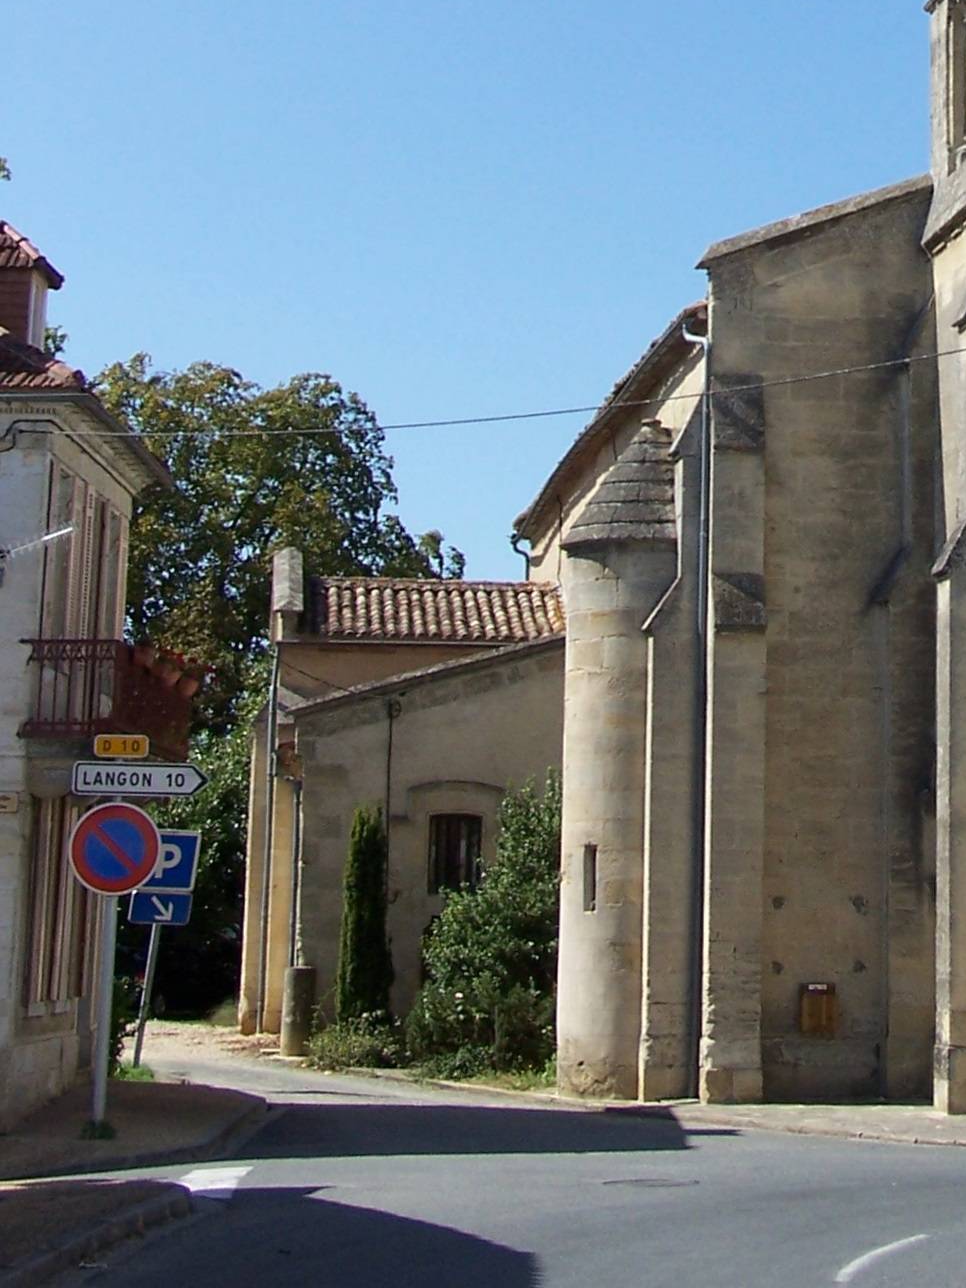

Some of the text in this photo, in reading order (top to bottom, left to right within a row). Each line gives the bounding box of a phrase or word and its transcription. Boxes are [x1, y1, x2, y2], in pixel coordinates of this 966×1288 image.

[103, 740, 140, 752] D 10
[83, 771, 185, 787] LANGON 10
[154, 843, 182, 879] P
